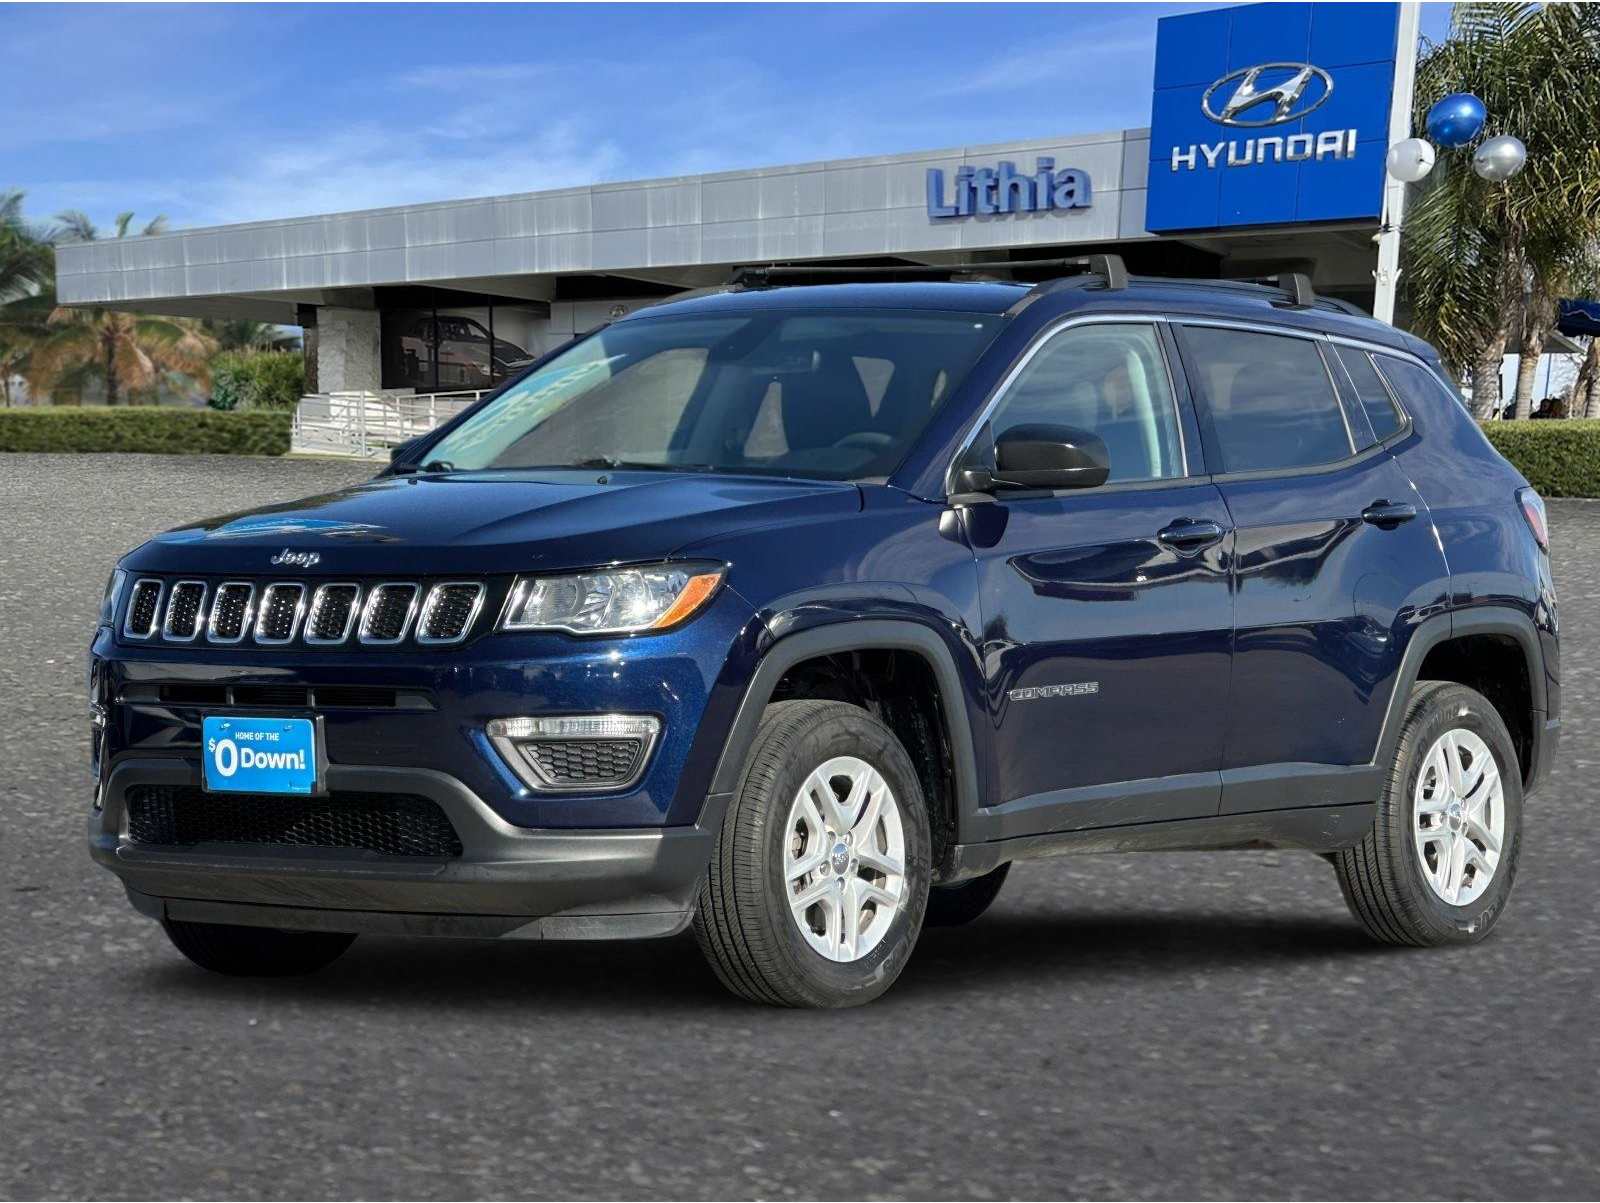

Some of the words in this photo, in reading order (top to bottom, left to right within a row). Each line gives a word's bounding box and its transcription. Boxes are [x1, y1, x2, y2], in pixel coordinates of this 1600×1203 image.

[1171, 128, 1358, 172] HYUNDAI
[926, 157, 1092, 219] Lithia
[270, 548, 321, 568] Jeep
[1009, 682, 1099, 701] COMPASS
[235, 732, 254, 741] HOME
[254, 732, 265, 741] OF
[265, 732, 279, 741] THE
[240, 748, 306, 769] Down!
